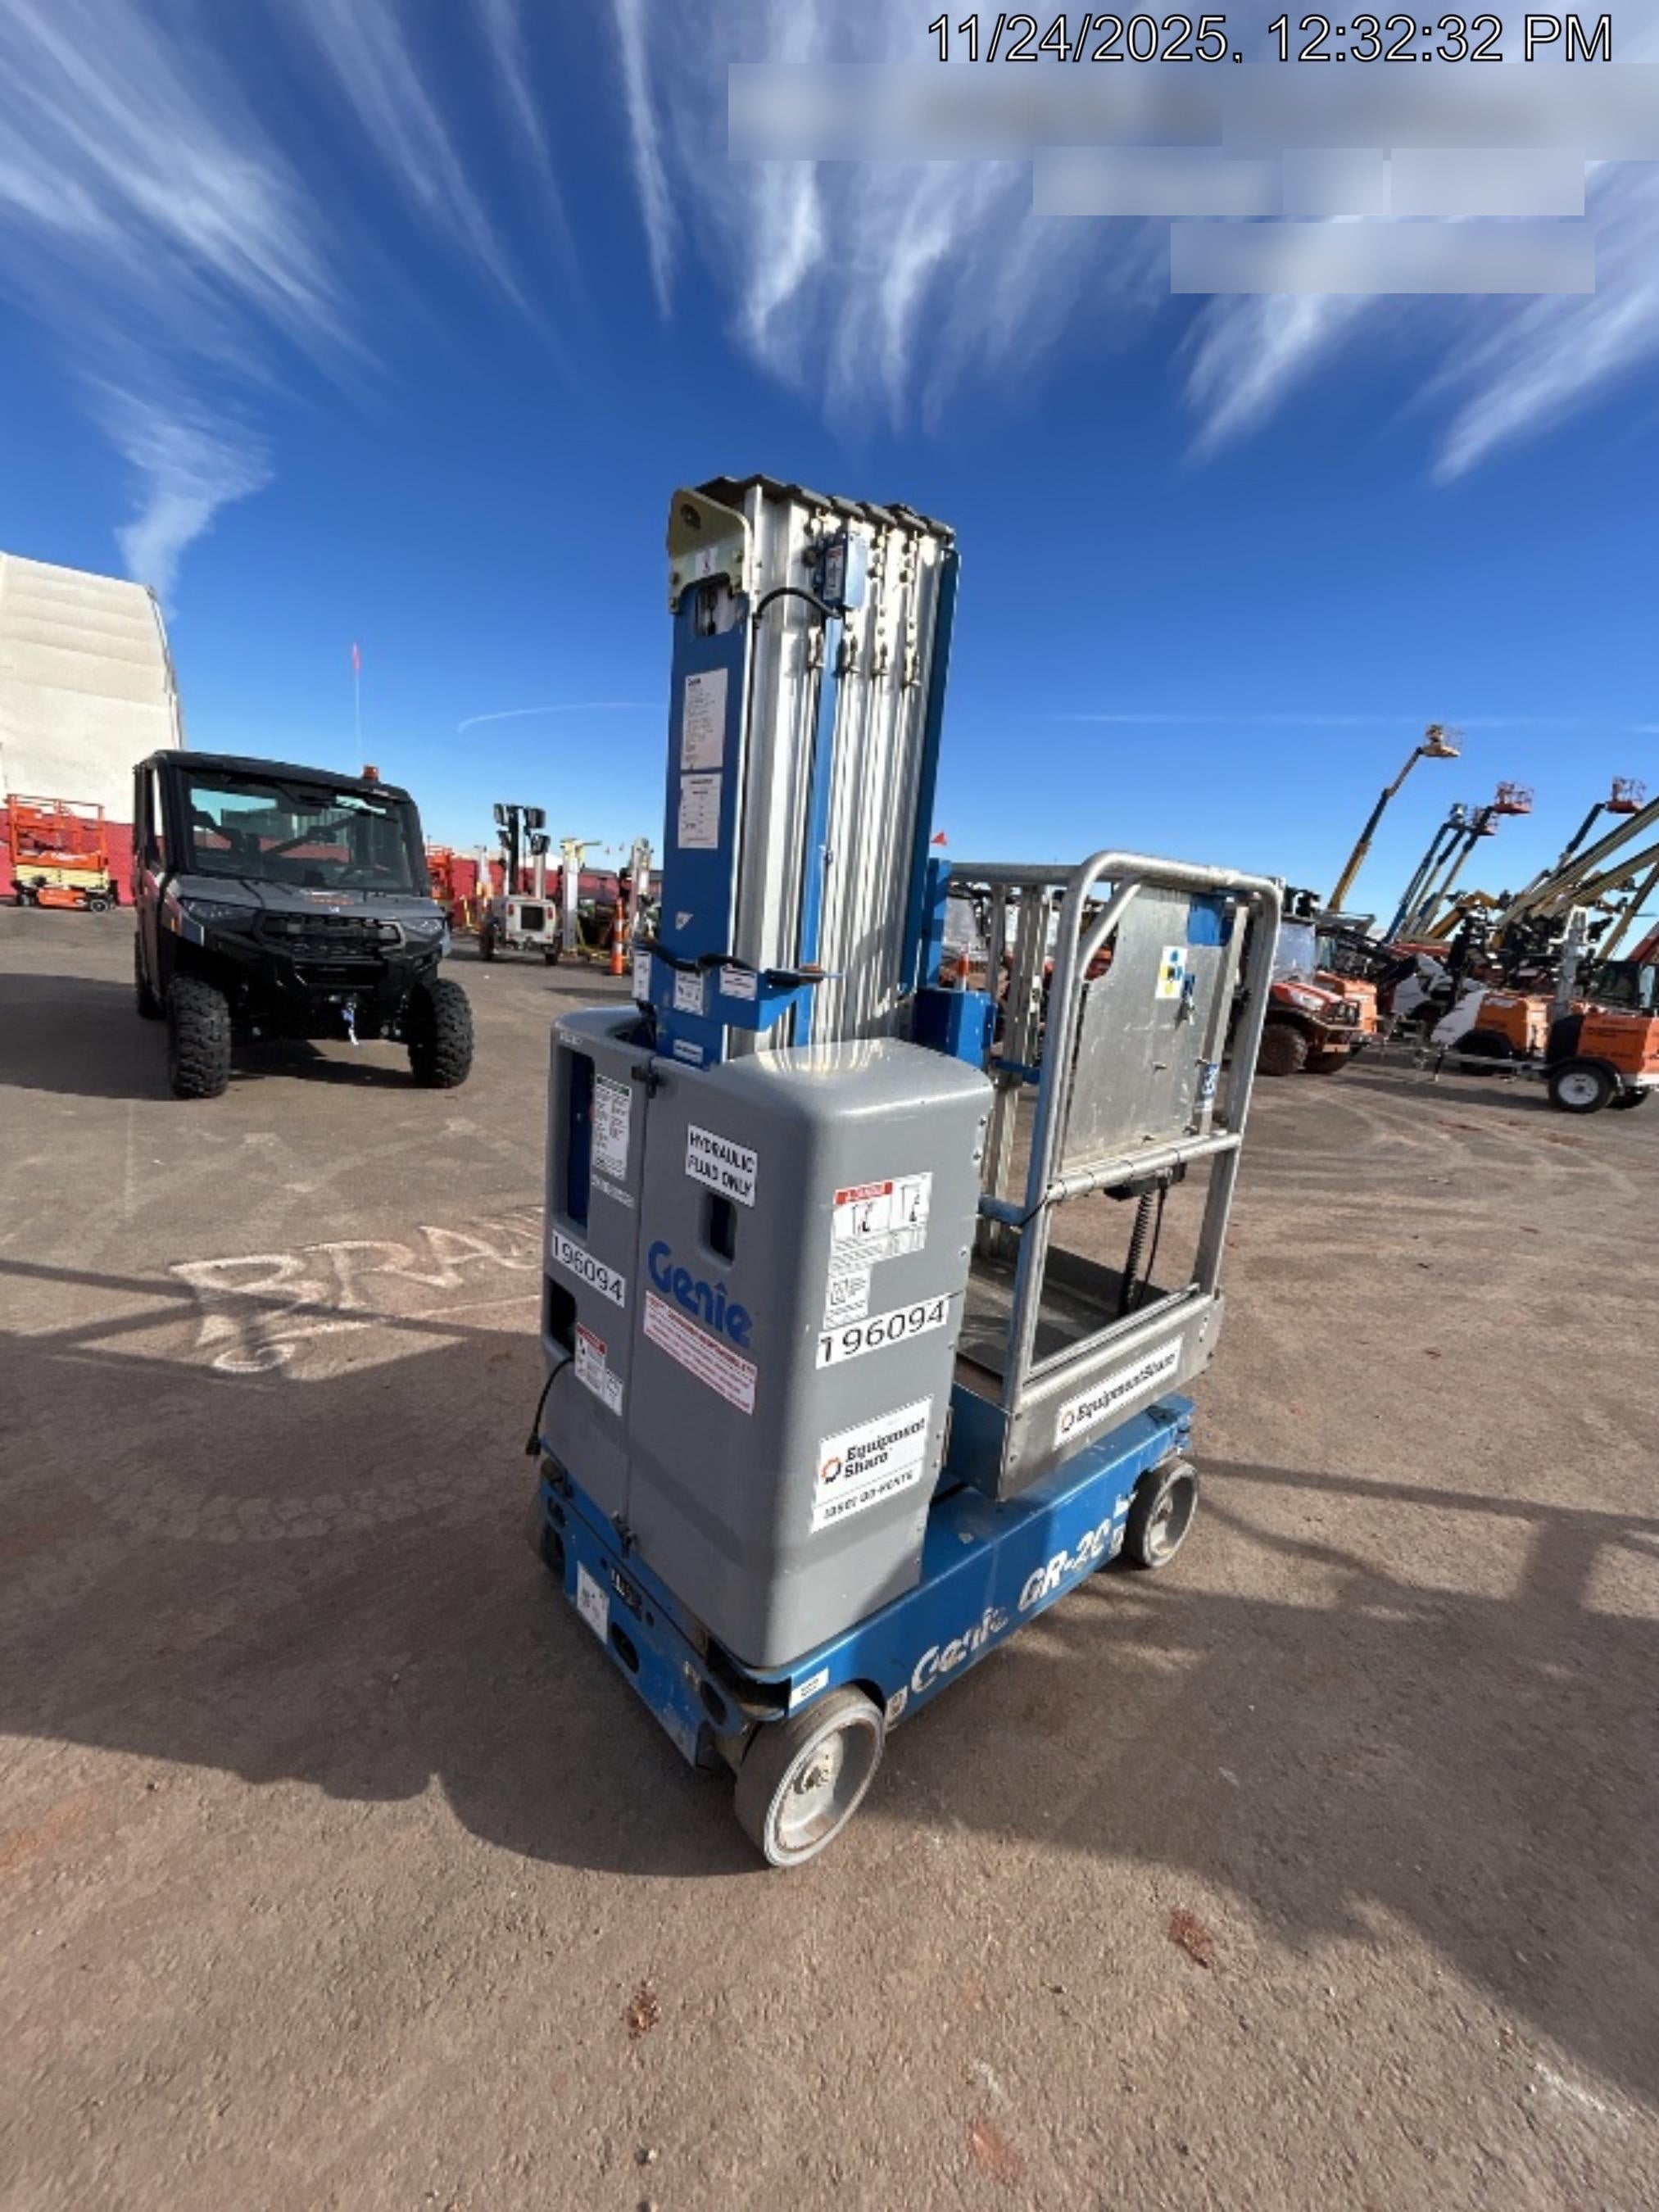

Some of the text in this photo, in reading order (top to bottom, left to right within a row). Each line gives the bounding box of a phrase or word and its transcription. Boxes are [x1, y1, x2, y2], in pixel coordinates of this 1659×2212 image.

[688, 1154, 752, 1198] FLUID ONLY
[691, 1131, 755, 1173] HYDRAULIC
[554, 1235, 623, 1302] 196094
[647, 1240, 753, 1348] Genie
[820, 1299, 945, 1362] 196094
